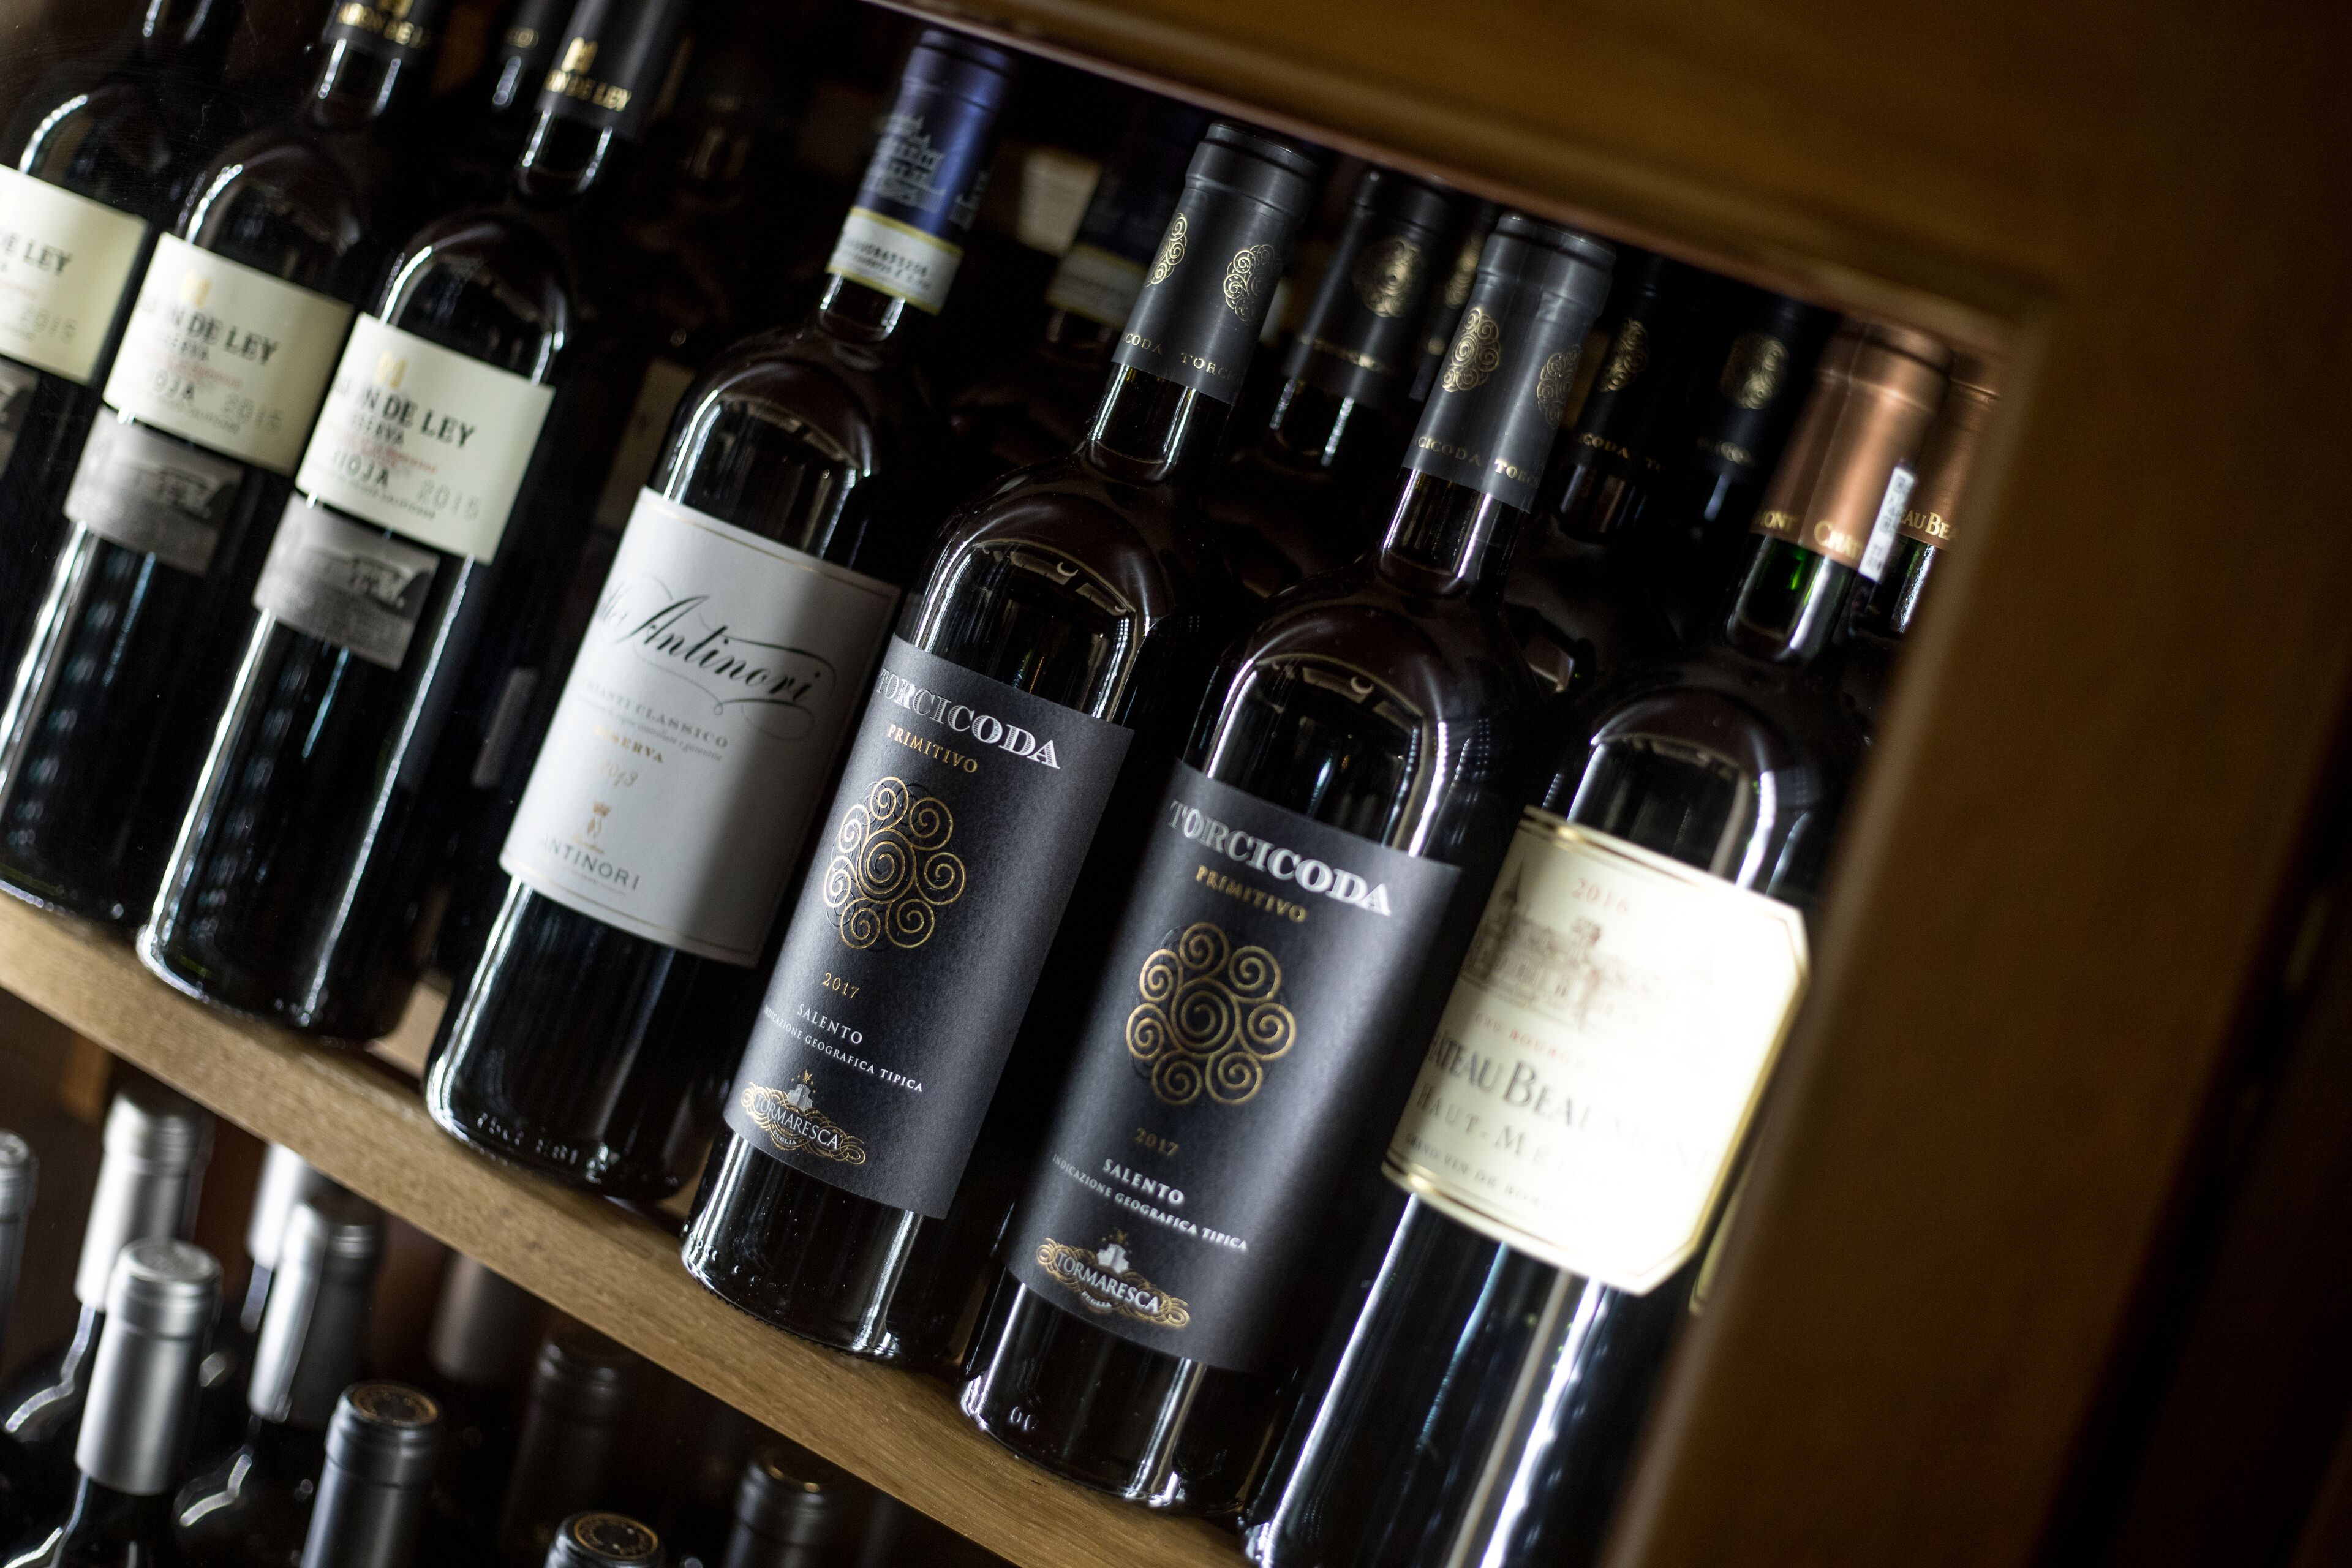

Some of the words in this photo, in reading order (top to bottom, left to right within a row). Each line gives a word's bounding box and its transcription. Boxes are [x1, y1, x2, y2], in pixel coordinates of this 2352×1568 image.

[24, 238, 72, 277] LEY
[224, 326, 278, 366] LEY
[1125, 333, 1162, 355] CODA
[382, 393, 418, 428] DE
[420, 409, 476, 448] LEY
[614, 595, 821, 701] Antinori
[876, 668, 1061, 771] TORCICODA
[888, 723, 978, 774] PRIMITIVO
[1167, 799, 1392, 918] TORCICODA
[1195, 864, 1308, 924] PRIMITIVO
[823, 972, 860, 999] 2017
[797, 1003, 863, 1044] SALENTO
[805, 1035, 875, 1075] GEOGRAFICA
[880, 1068, 923, 1093] TIPICA
[754, 1093, 839, 1150] TORMARESCA
[772, 1130, 797, 1146] PUGLIA
[1133, 1127, 1180, 1158] 2017
[1052, 1154, 1112, 1197] INDICAZIONE
[1115, 1192, 1197, 1236] GEOGRAFICA
[1201, 1227, 1248, 1253] TIPICA
[1102, 1158, 1185, 1205] SALENTO
[1055, 1251, 1160, 1314] TORMARESCA
